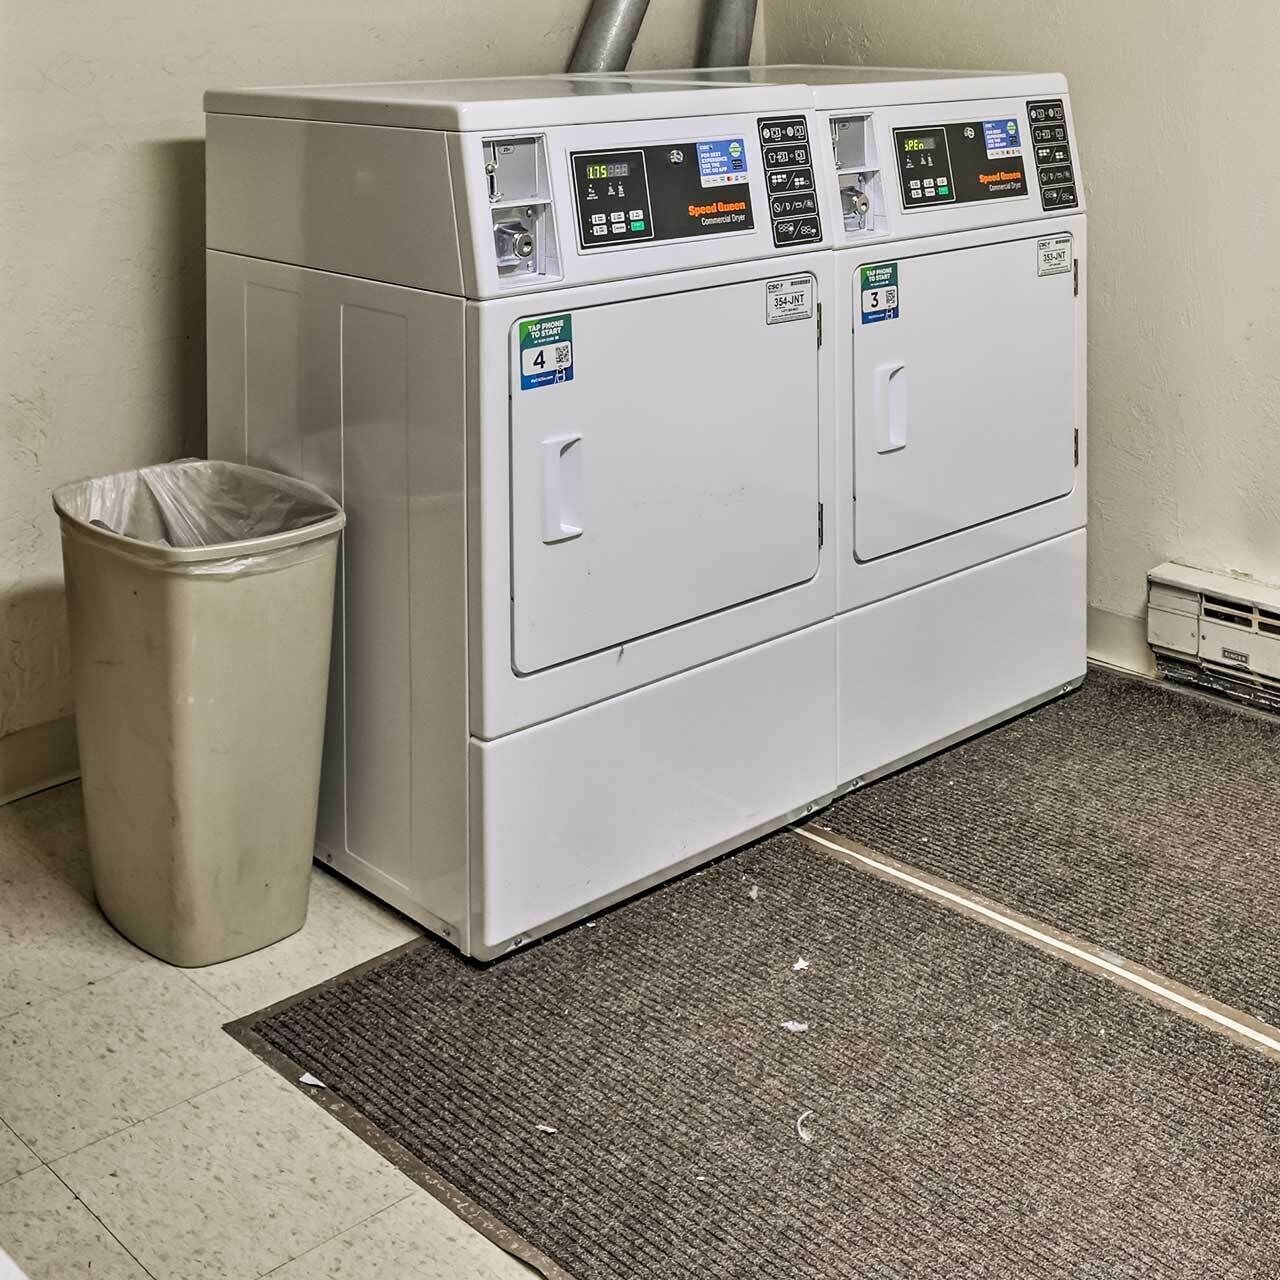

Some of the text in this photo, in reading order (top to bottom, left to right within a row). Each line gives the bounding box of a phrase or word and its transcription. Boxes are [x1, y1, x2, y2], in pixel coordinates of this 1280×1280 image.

[979, 172, 1021, 184] Speed Queen
[688, 202, 746, 217] Speed Queen
[702, 214, 745, 225] Commercial Dryer
[774, 294, 804, 307] 354-JNT
[871, 292, 878, 307] 3
[542, 320, 564, 329] PHONE
[541, 327, 561, 337] START
[533, 350, 545, 369] 4
